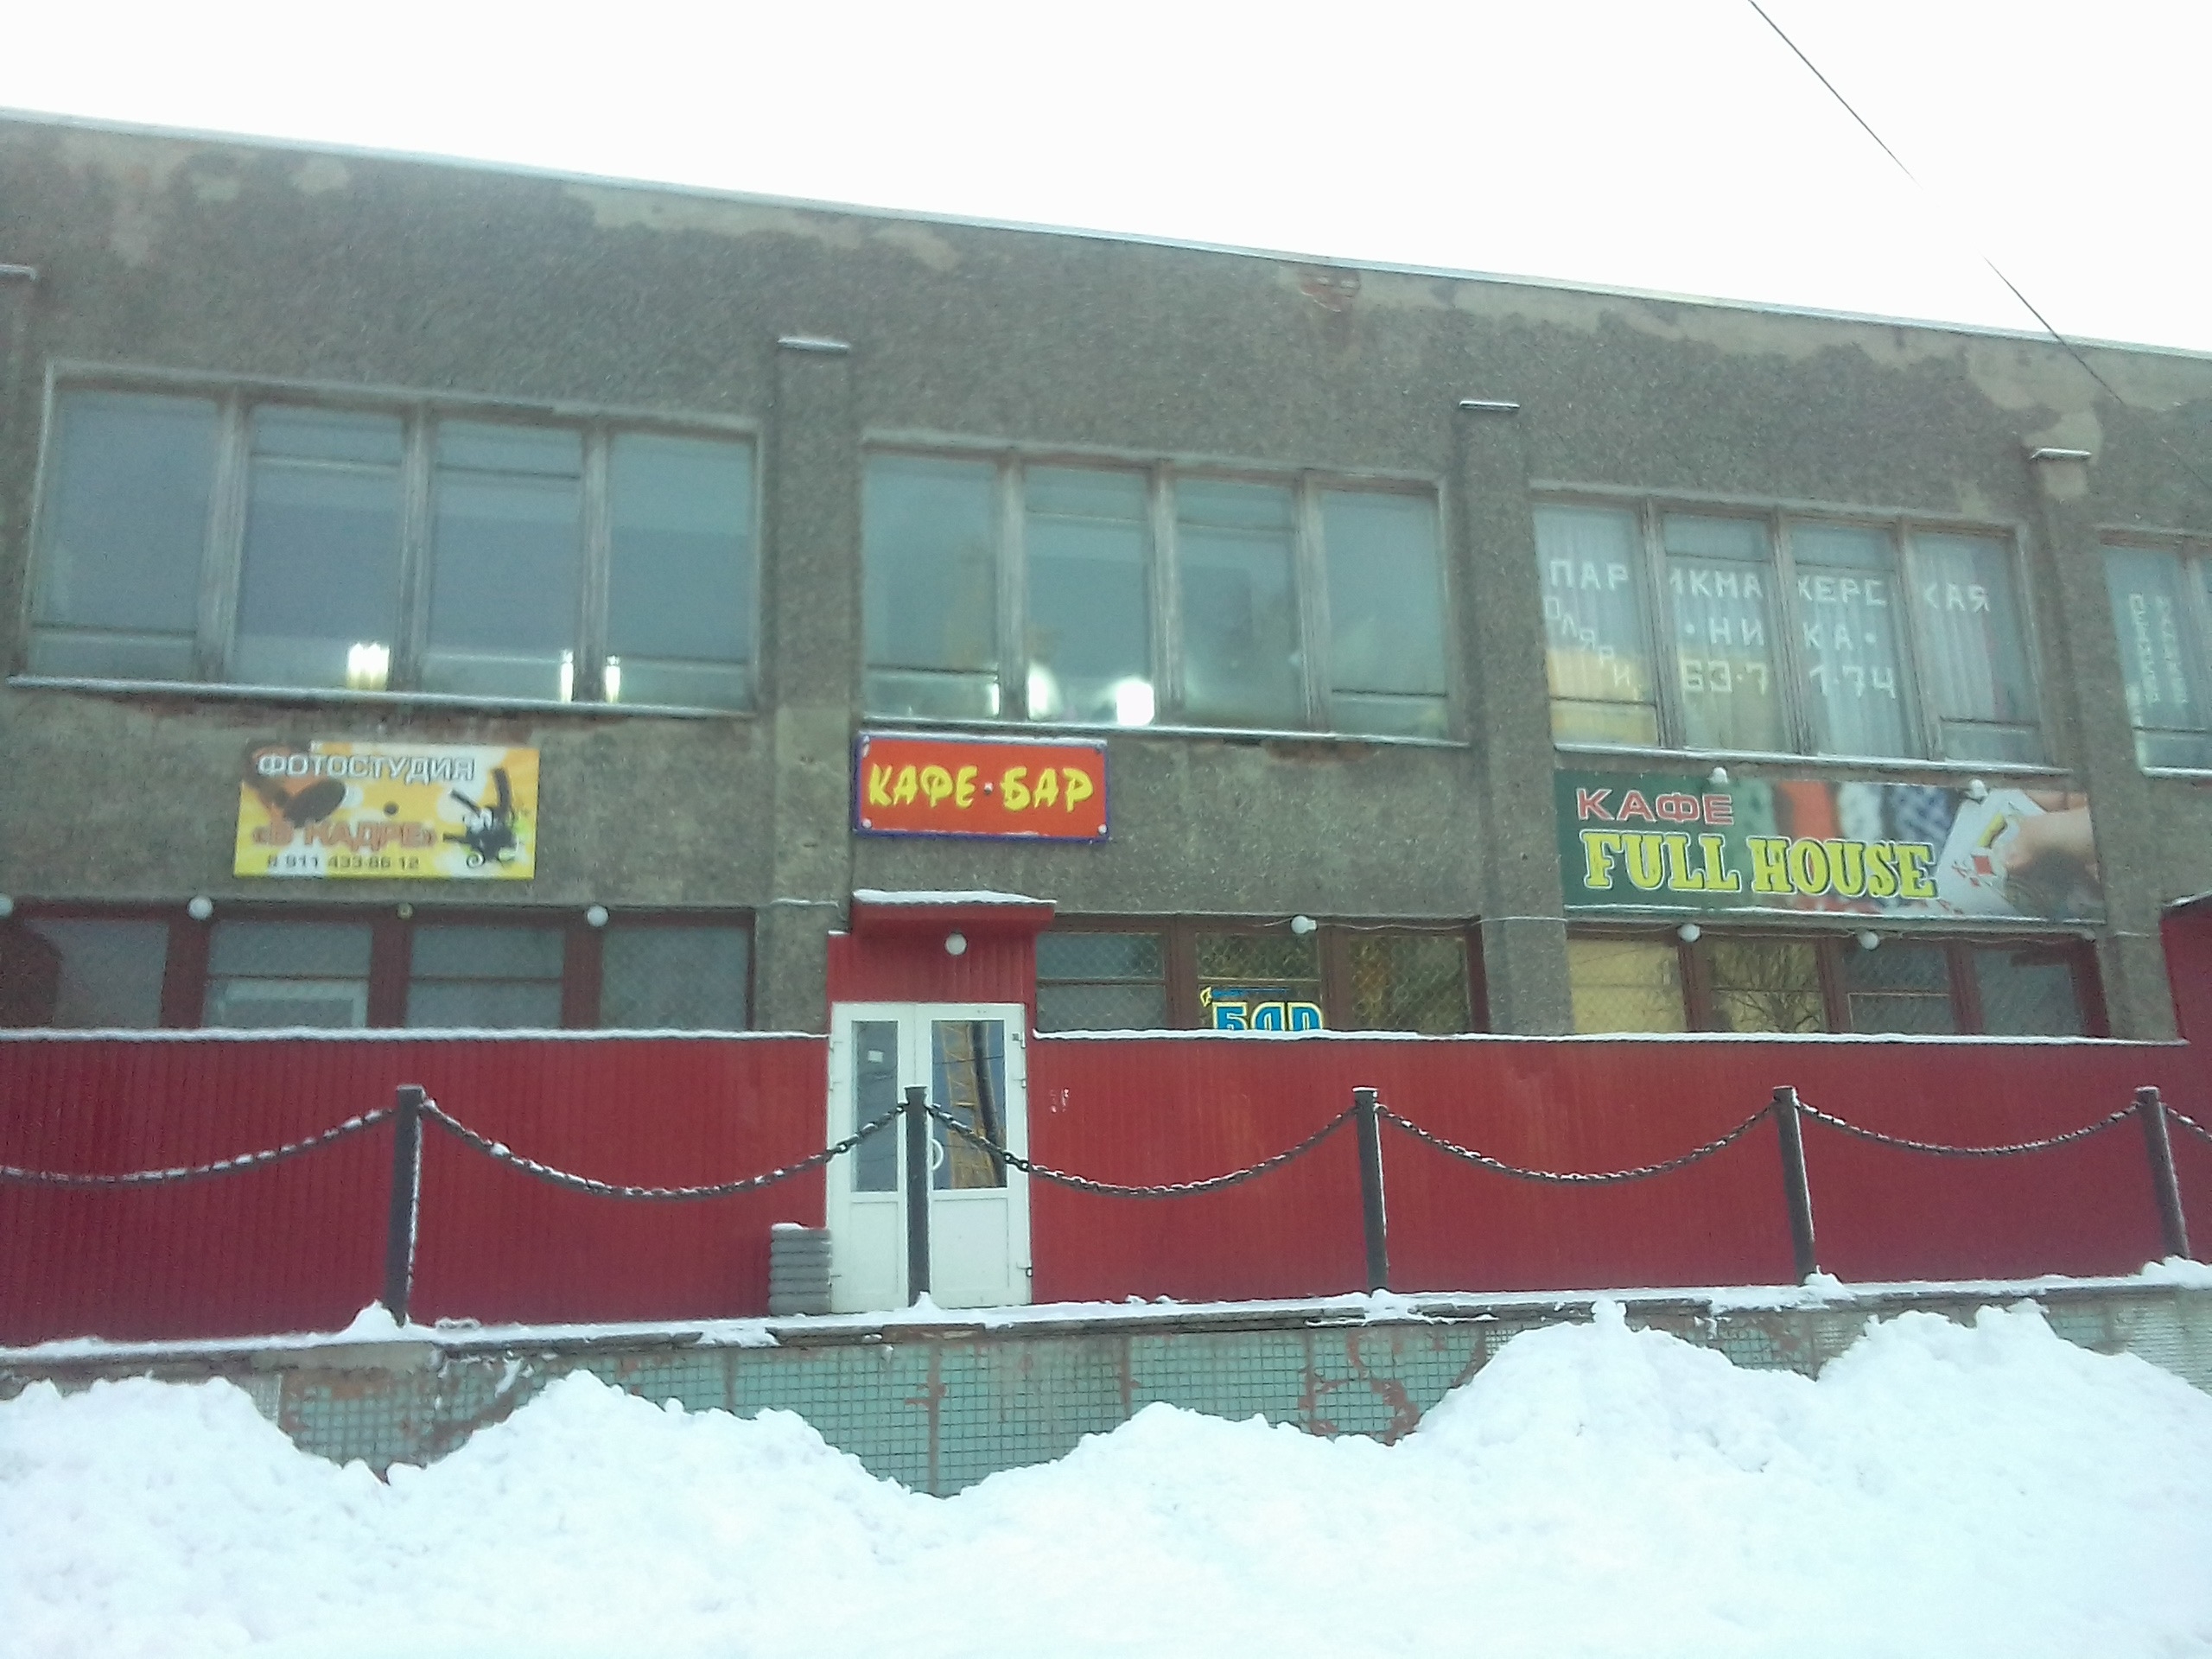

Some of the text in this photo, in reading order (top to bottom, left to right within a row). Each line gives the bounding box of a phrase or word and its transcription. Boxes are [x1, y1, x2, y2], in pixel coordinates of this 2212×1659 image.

[257, 753, 476, 784] ФОТОСТУДИЯ
[868, 763, 1095, 813] КАФЕ БАР
[1575, 787, 1734, 824] КАФЕ
[1580, 828, 1940, 899] FULL HOUSE
